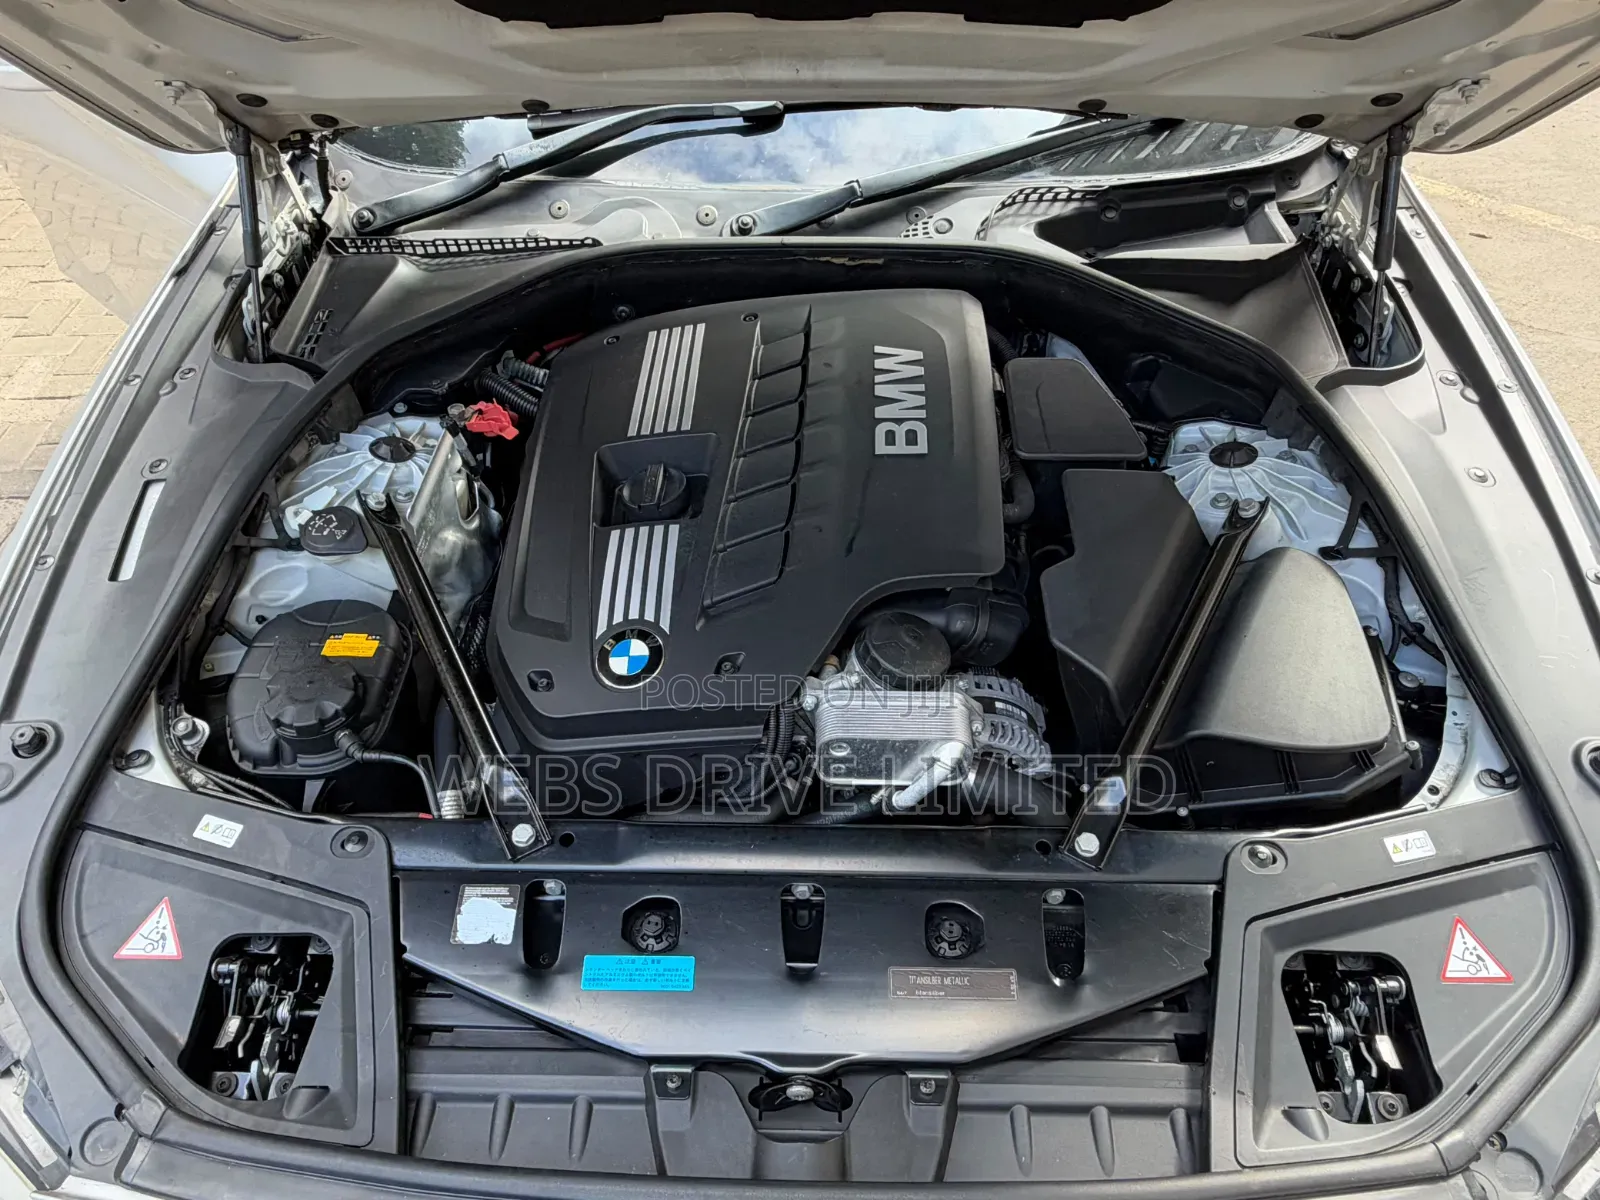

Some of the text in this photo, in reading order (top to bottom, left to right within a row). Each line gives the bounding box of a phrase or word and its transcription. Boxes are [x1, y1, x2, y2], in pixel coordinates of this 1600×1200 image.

[873, 345, 928, 455] BMW
[603, 629, 660, 650] BMW
[943, 976, 971, 987] METALLIC
